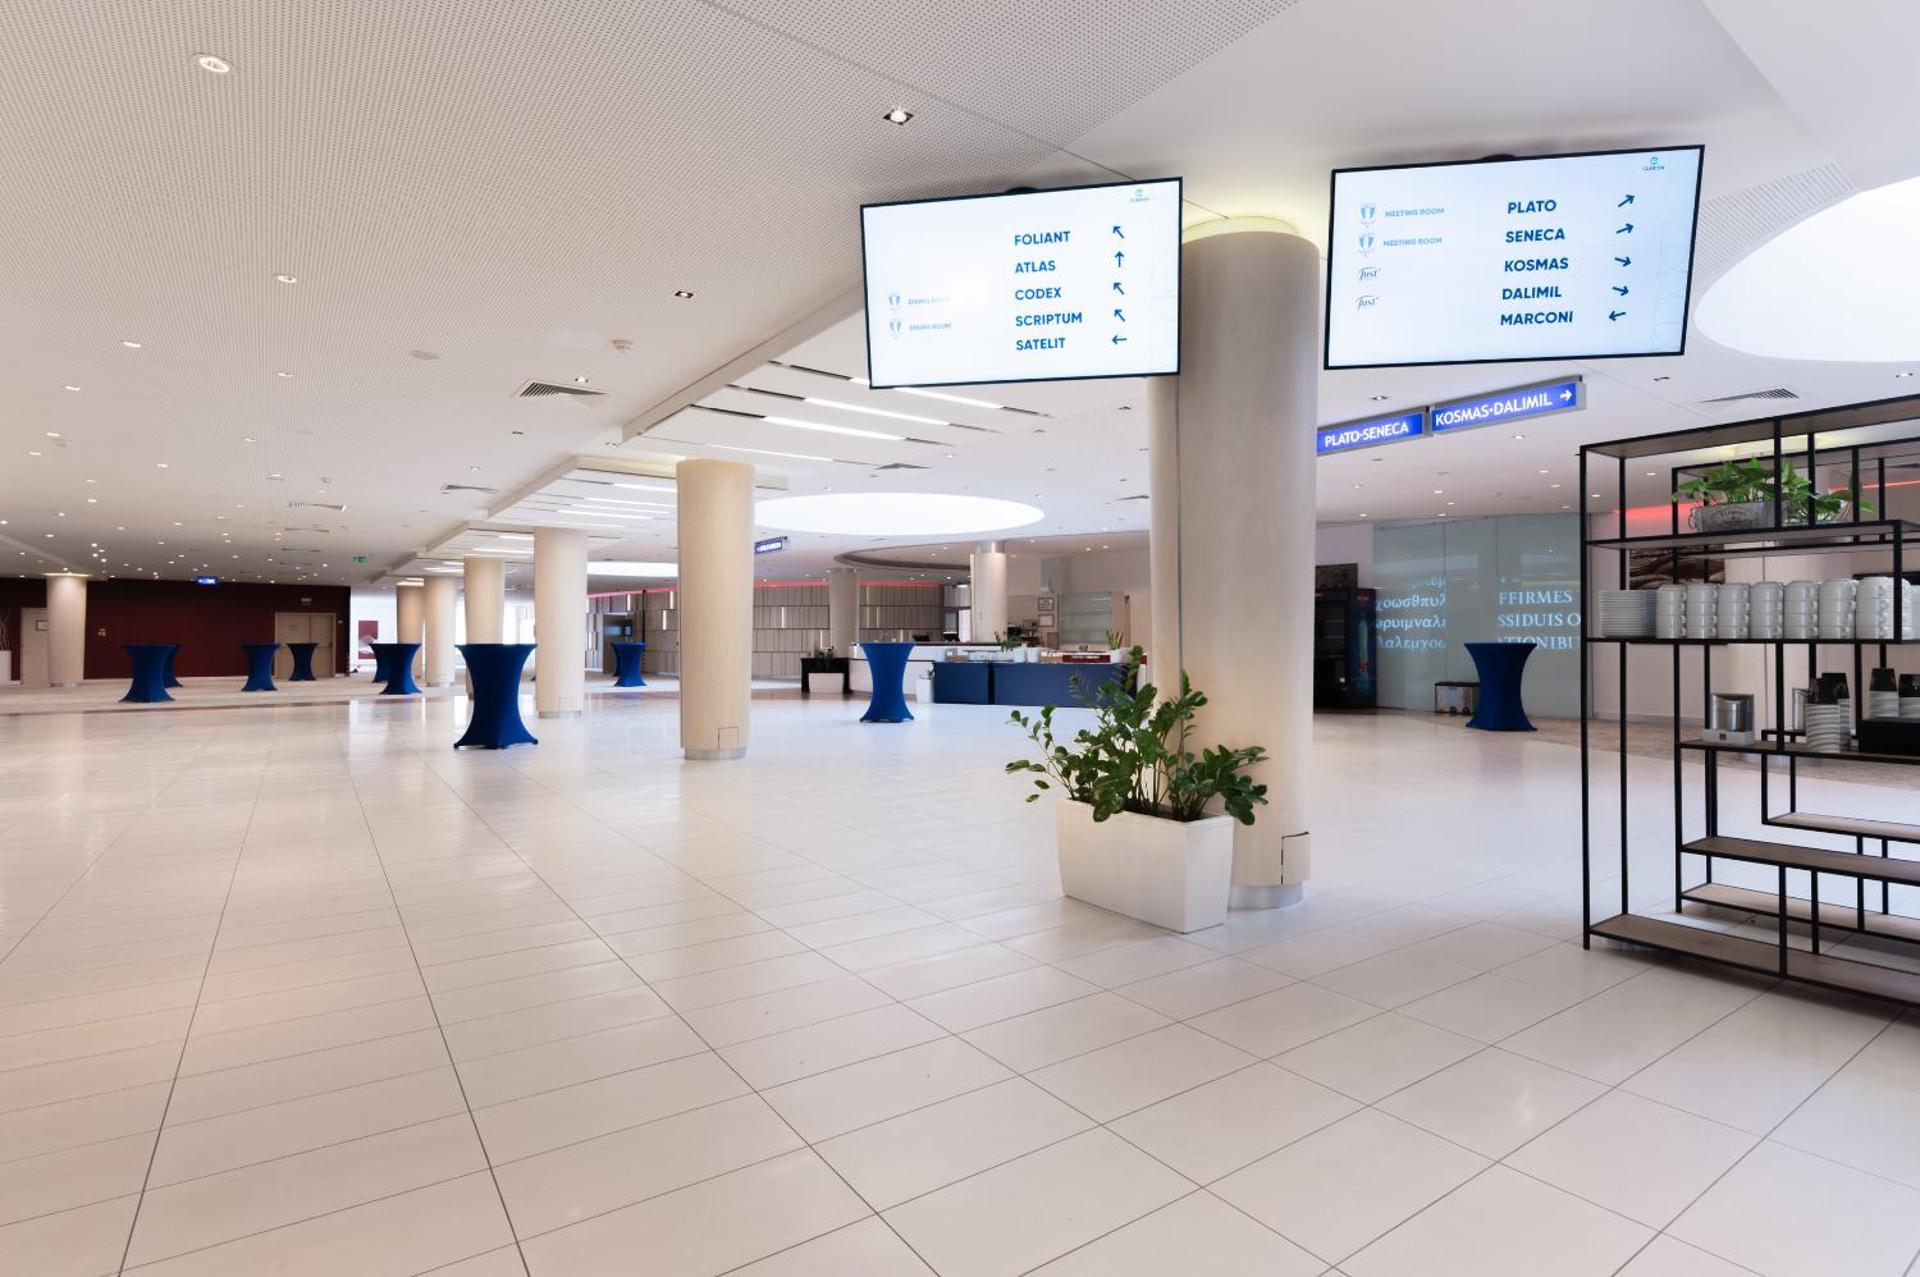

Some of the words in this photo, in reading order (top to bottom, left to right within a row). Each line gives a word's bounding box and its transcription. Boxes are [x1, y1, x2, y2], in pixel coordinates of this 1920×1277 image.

[1507, 199, 1557, 215] PLATO
[1014, 230, 1072, 247] FOLIANT
[1505, 227, 1566, 243] SENECA
[1014, 260, 1057, 275] ATLAS
[1504, 257, 1569, 273] KOSMAS
[1014, 287, 1063, 301] CODEX
[1501, 286, 1562, 301] DALIMIL
[1015, 311, 1083, 328] SCRIPTUM
[1500, 310, 1574, 327] MARCONI
[1016, 337, 1067, 351] SATELIT
[1497, 613, 1564, 627] SSIDUIS
